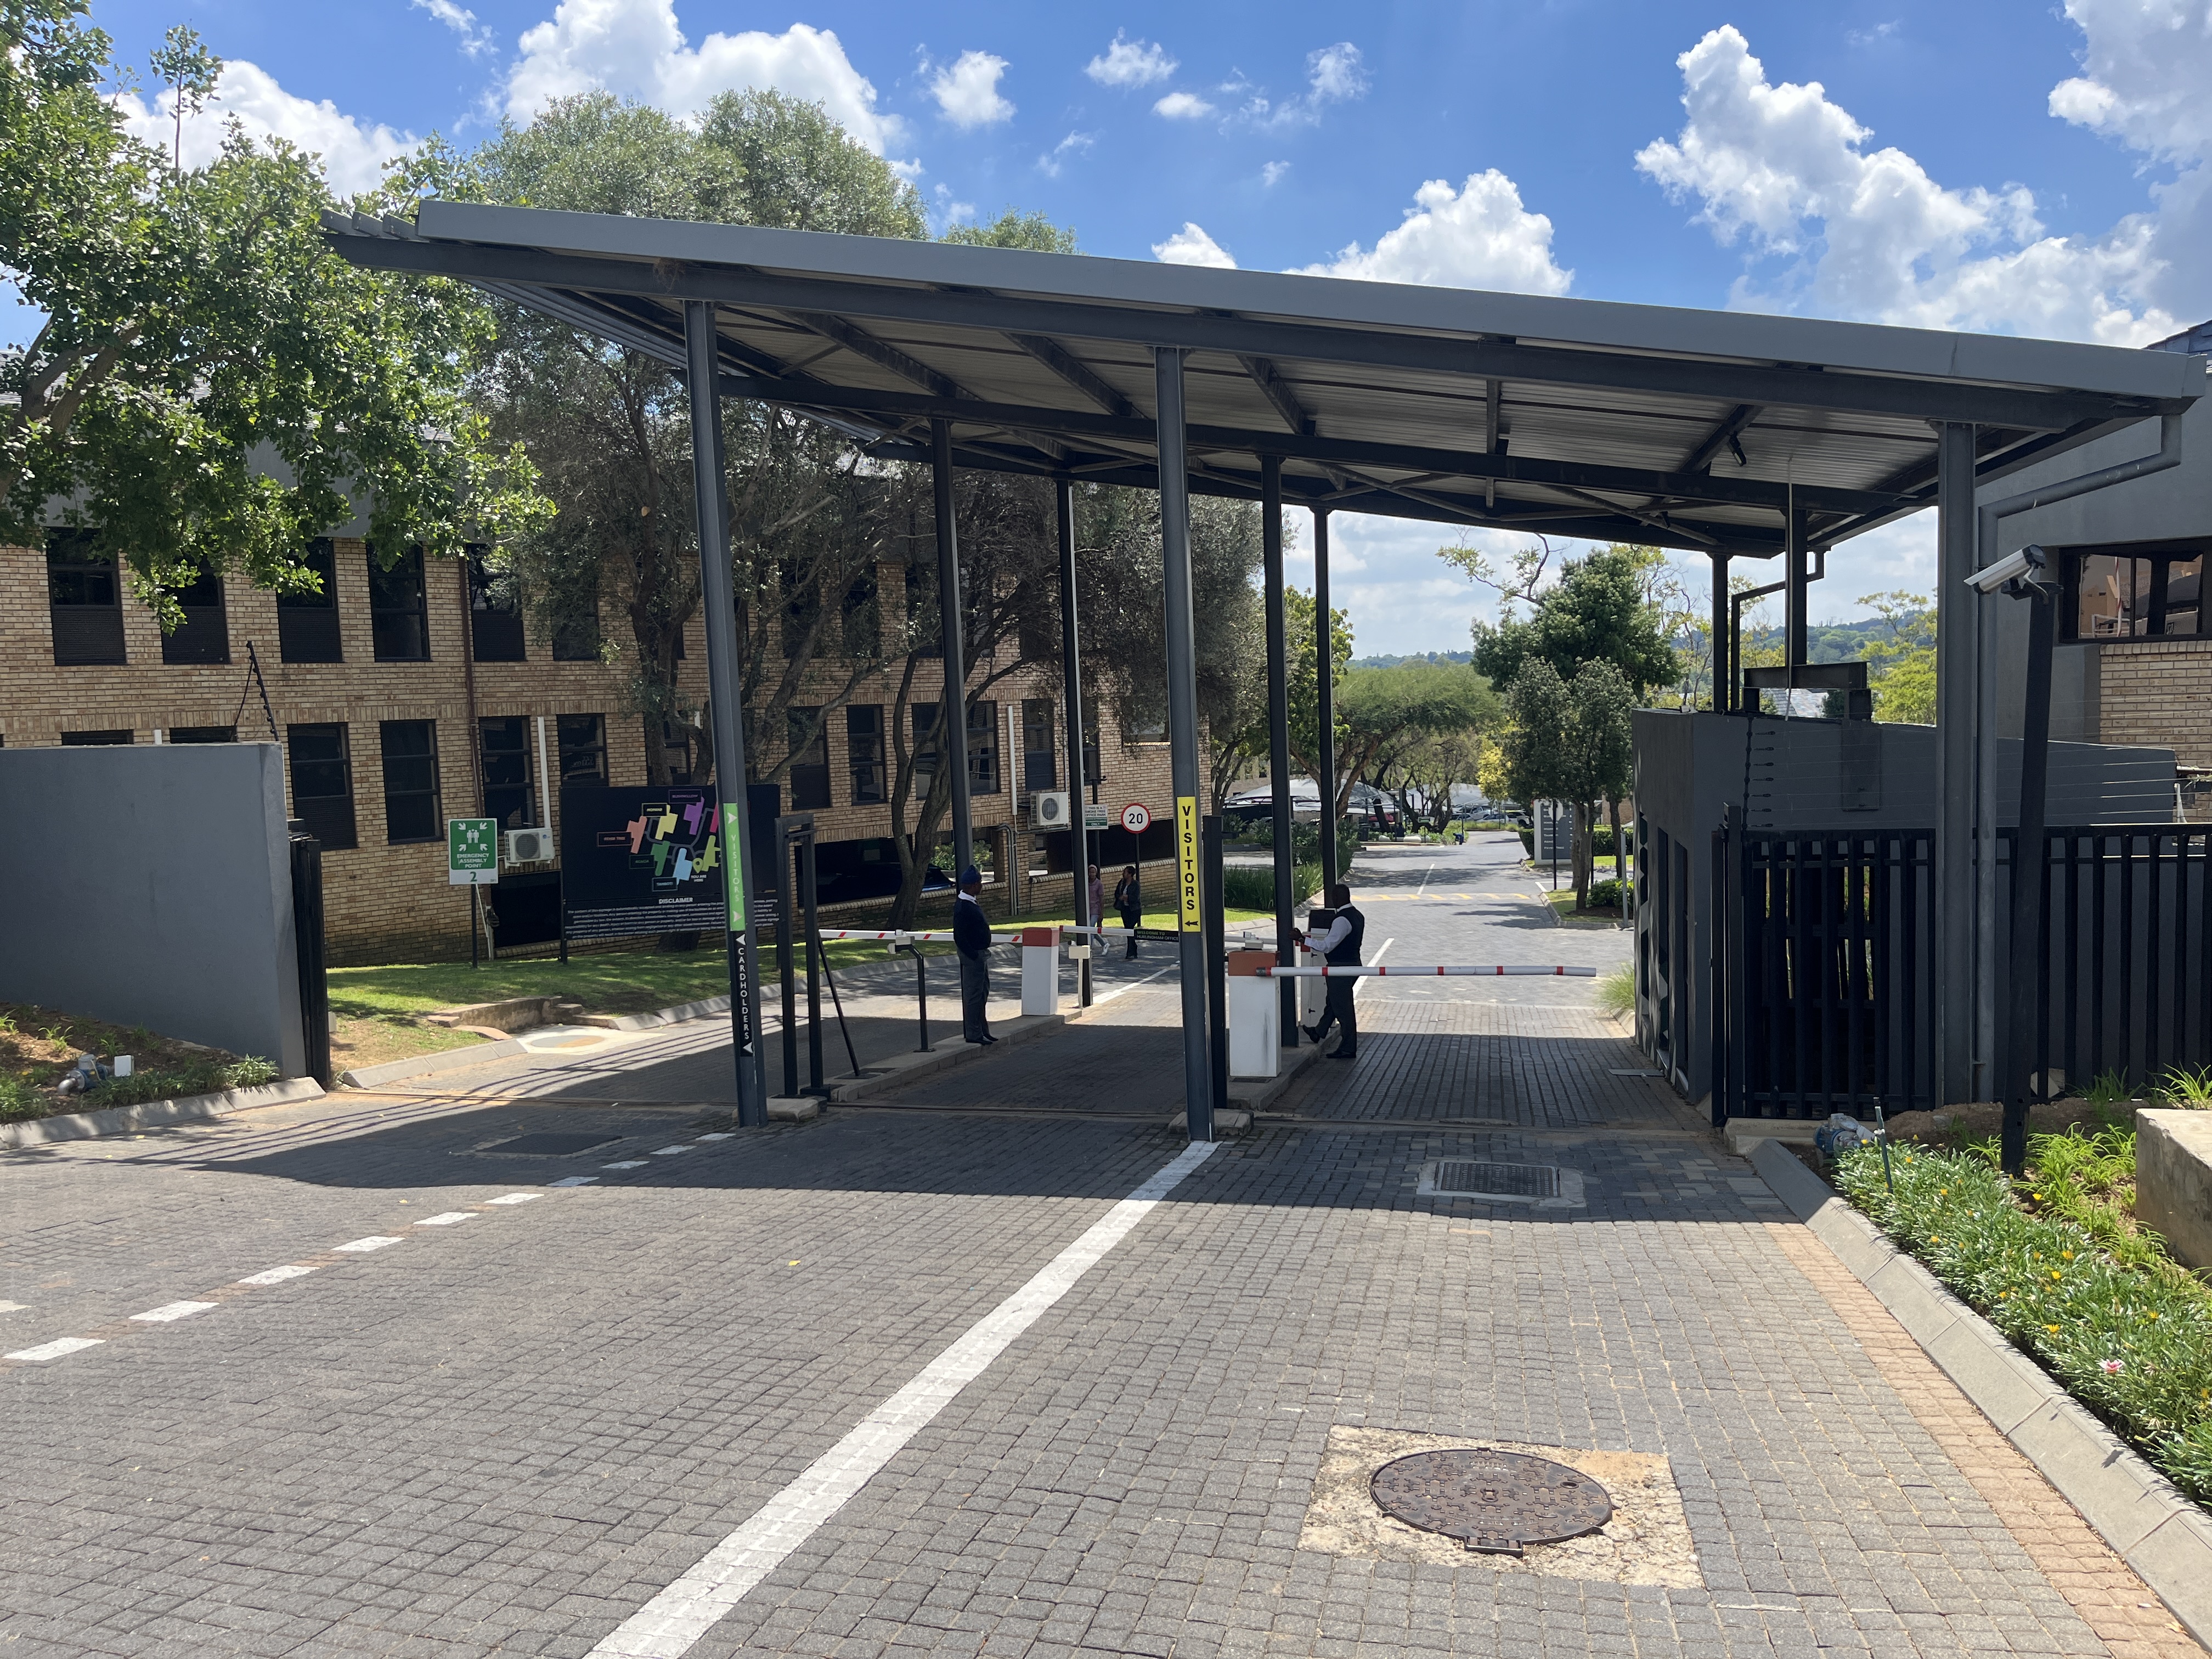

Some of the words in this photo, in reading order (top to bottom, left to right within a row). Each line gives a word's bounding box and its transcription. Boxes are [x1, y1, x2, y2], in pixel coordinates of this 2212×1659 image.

[1128, 813, 1143, 824] 20
[470, 871, 477, 882] 2
[731, 834, 740, 901] VISITORS
[1182, 805, 1195, 910] VISITORS
[738, 947, 749, 1040] CARDHOLDERS
